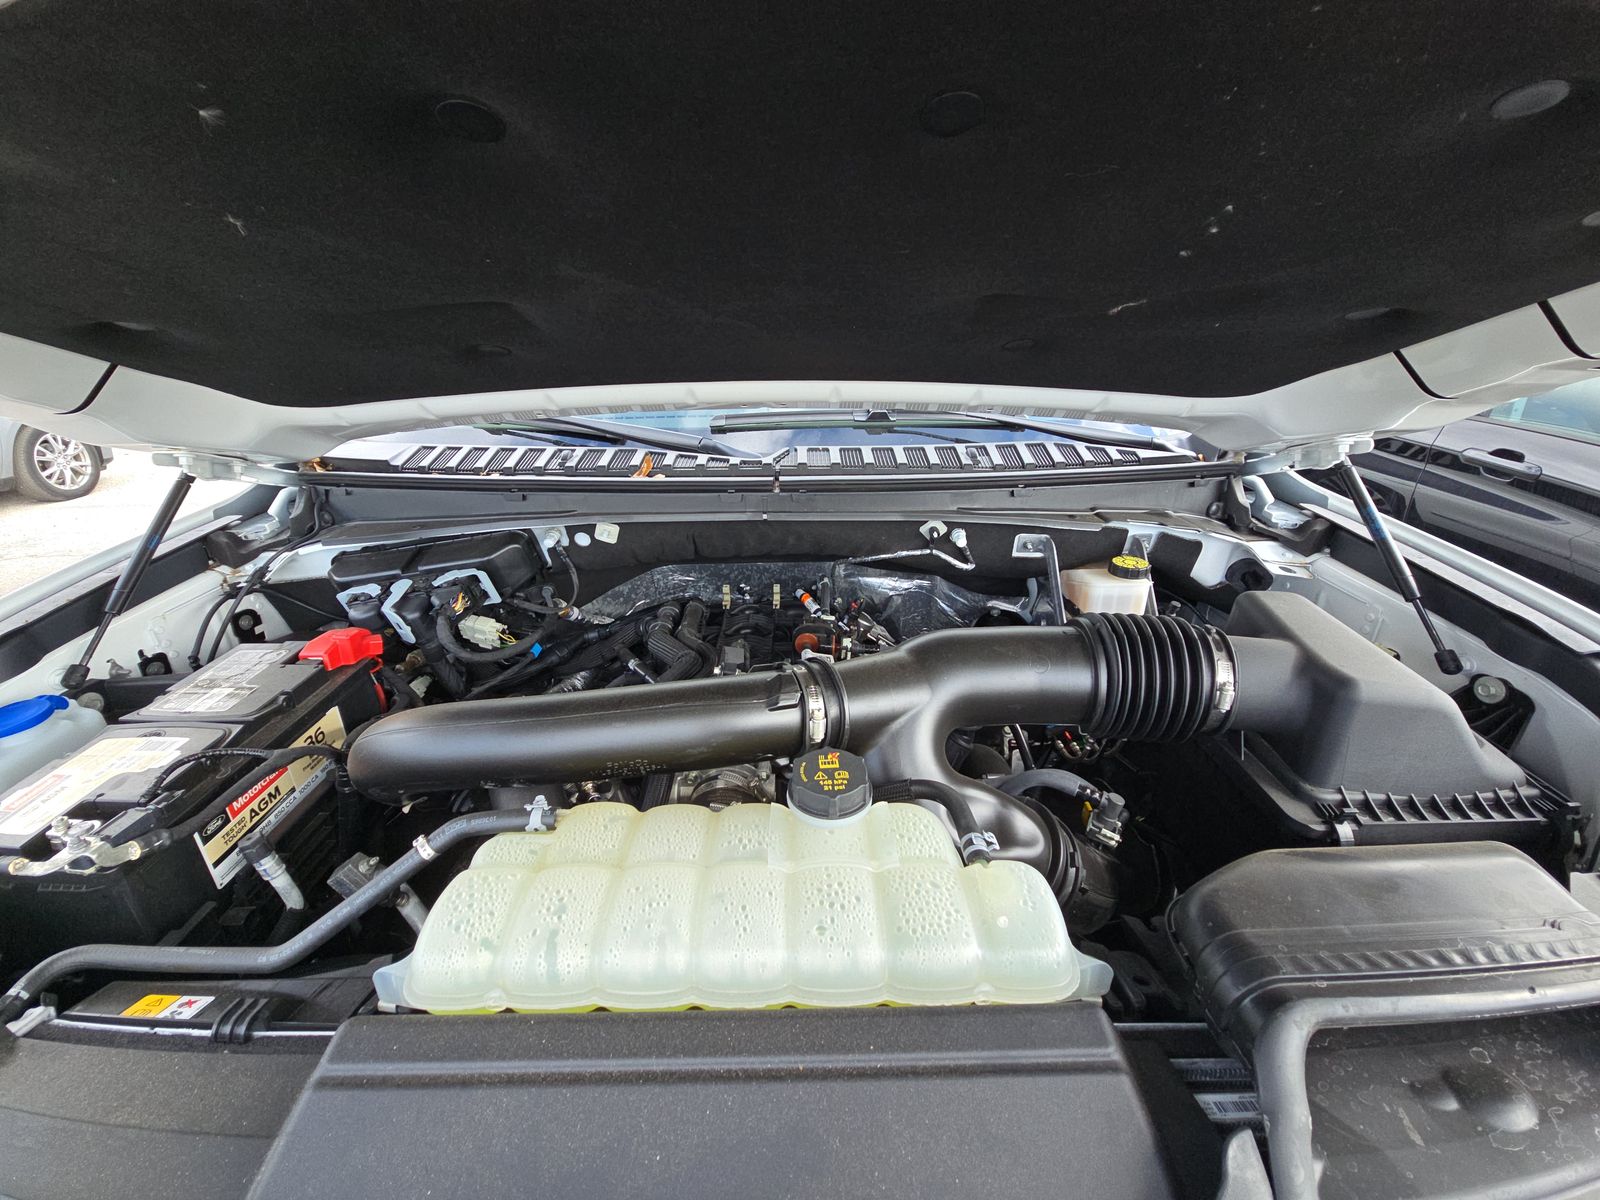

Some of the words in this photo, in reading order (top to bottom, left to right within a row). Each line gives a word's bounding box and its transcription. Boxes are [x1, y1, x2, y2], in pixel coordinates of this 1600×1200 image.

[304, 727, 325, 745] 36
[249, 785, 281, 823] AGM
[274, 806, 286, 820] 850
[285, 795, 297, 808] CCA
[299, 781, 312, 795] 1000
[311, 774, 319, 784] CA
[221, 816, 246, 840] TESTED
